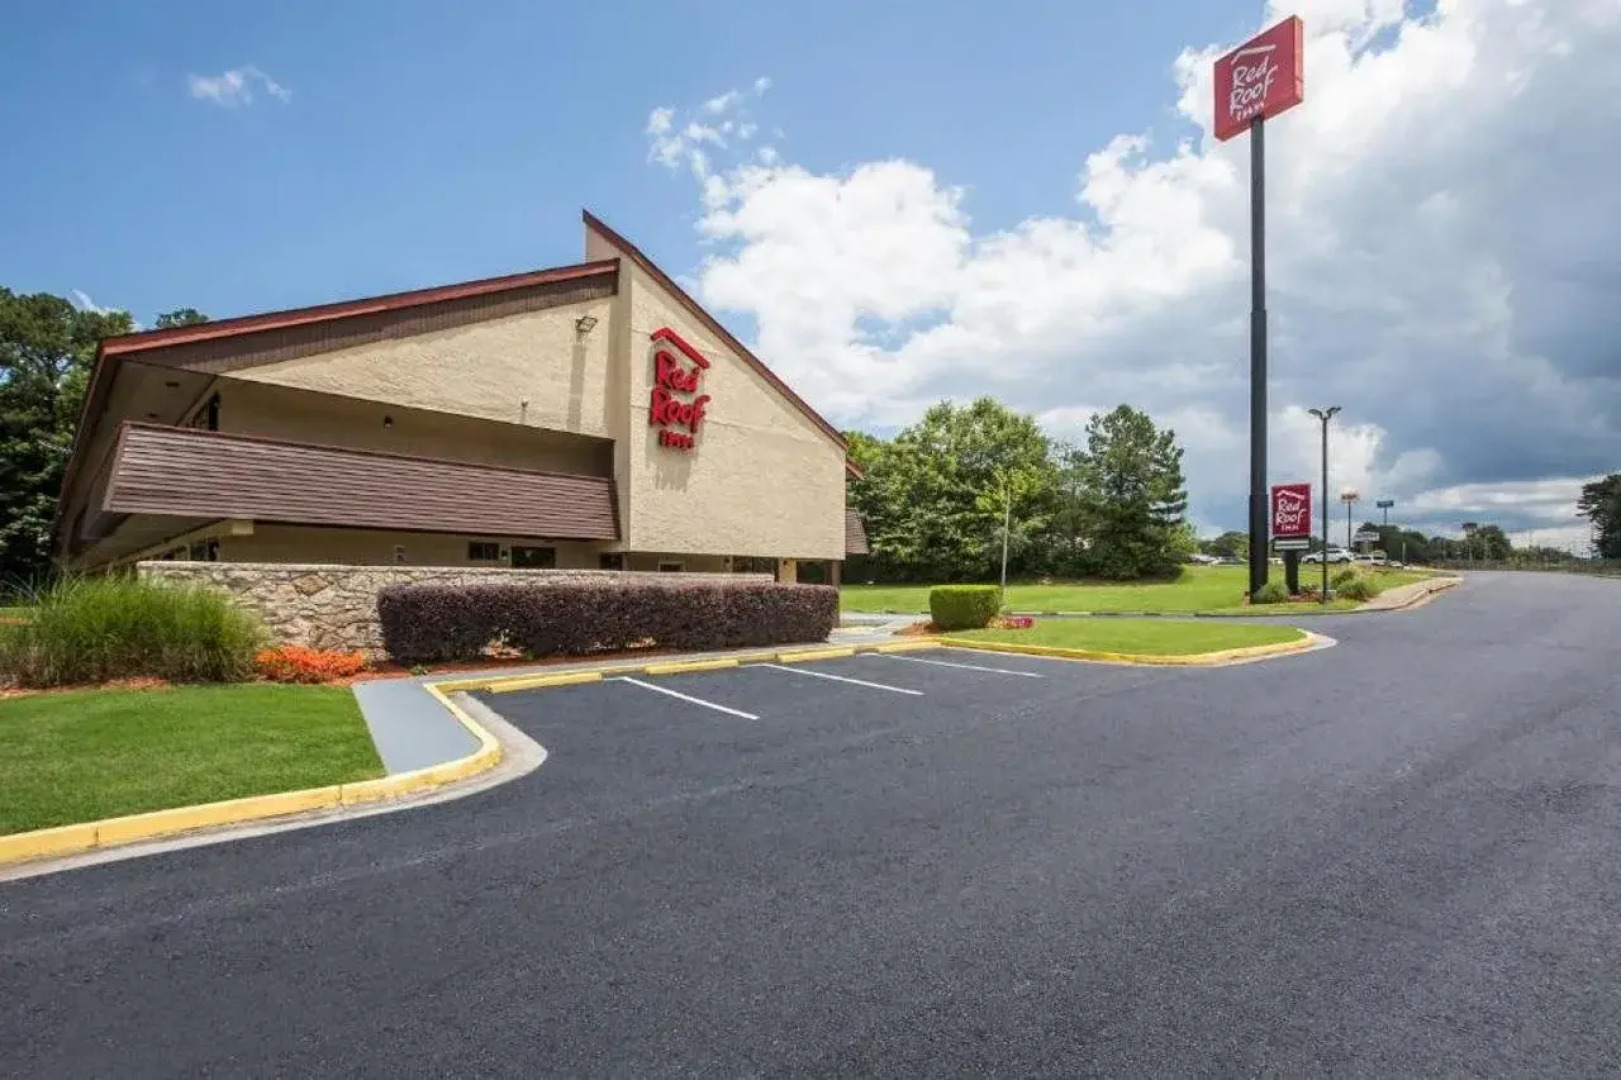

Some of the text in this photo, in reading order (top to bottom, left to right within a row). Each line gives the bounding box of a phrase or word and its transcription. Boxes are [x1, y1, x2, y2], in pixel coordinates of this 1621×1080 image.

[1229, 64, 1278, 117] Roof
[1232, 55, 1269, 88] Red
[655, 350, 701, 393] Red
[650, 386, 711, 434] Roof
[1275, 508, 1307, 526] Roof
[1278, 499, 1300, 512] Red
